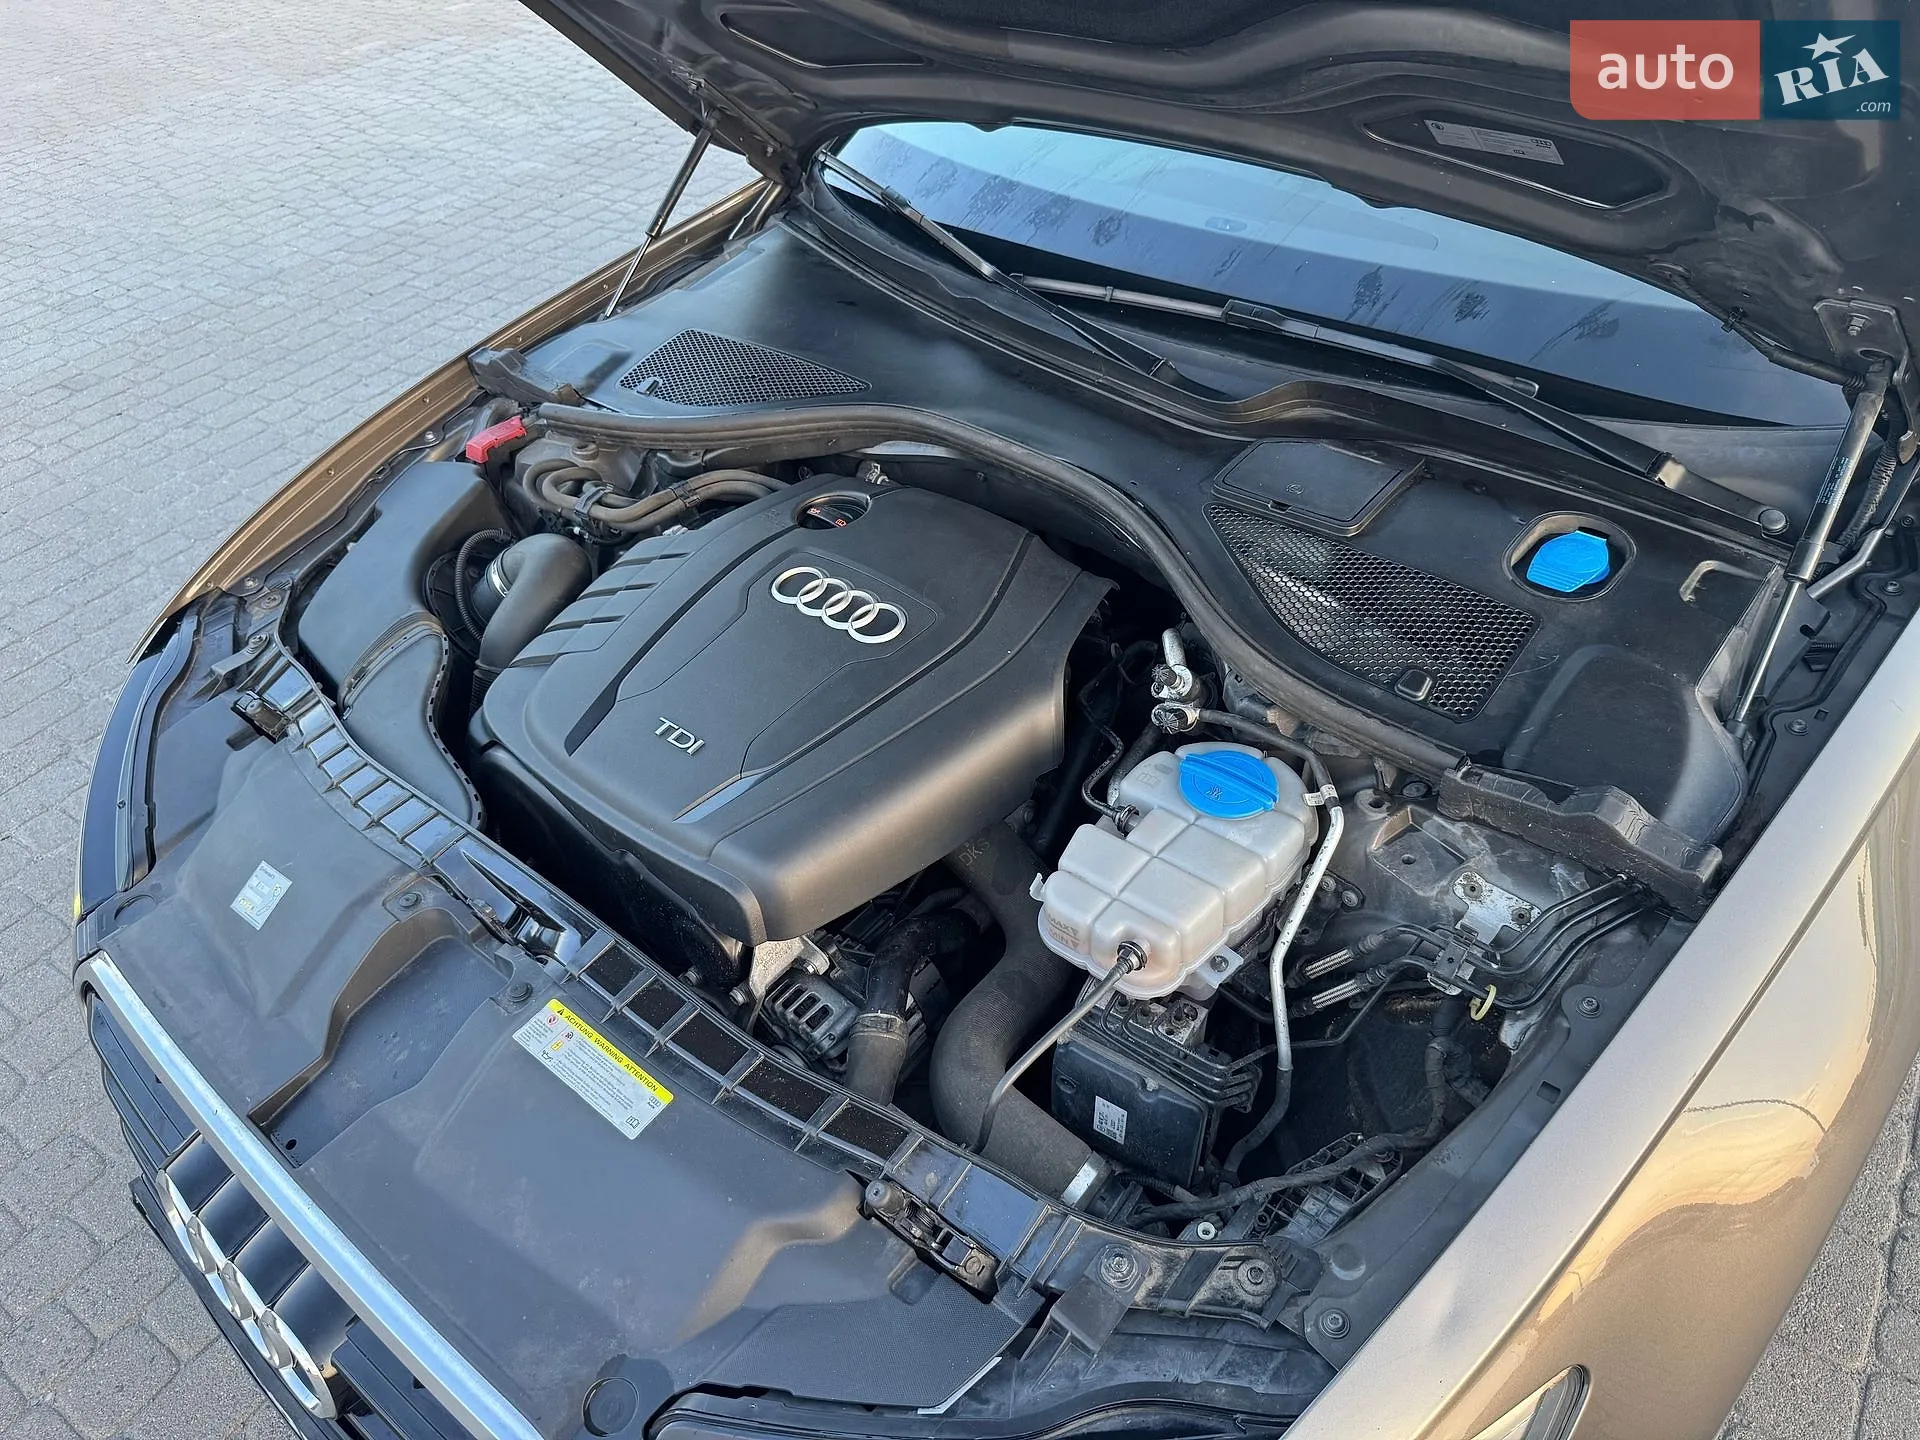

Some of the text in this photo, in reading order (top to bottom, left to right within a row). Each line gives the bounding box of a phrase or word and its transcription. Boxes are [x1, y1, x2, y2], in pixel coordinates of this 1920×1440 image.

[654, 716, 705, 755] TDI
[565, 1015, 594, 1039] ACHTUNG
[594, 1037, 623, 1064] WARNING
[624, 1062, 659, 1092] ATTENTION
